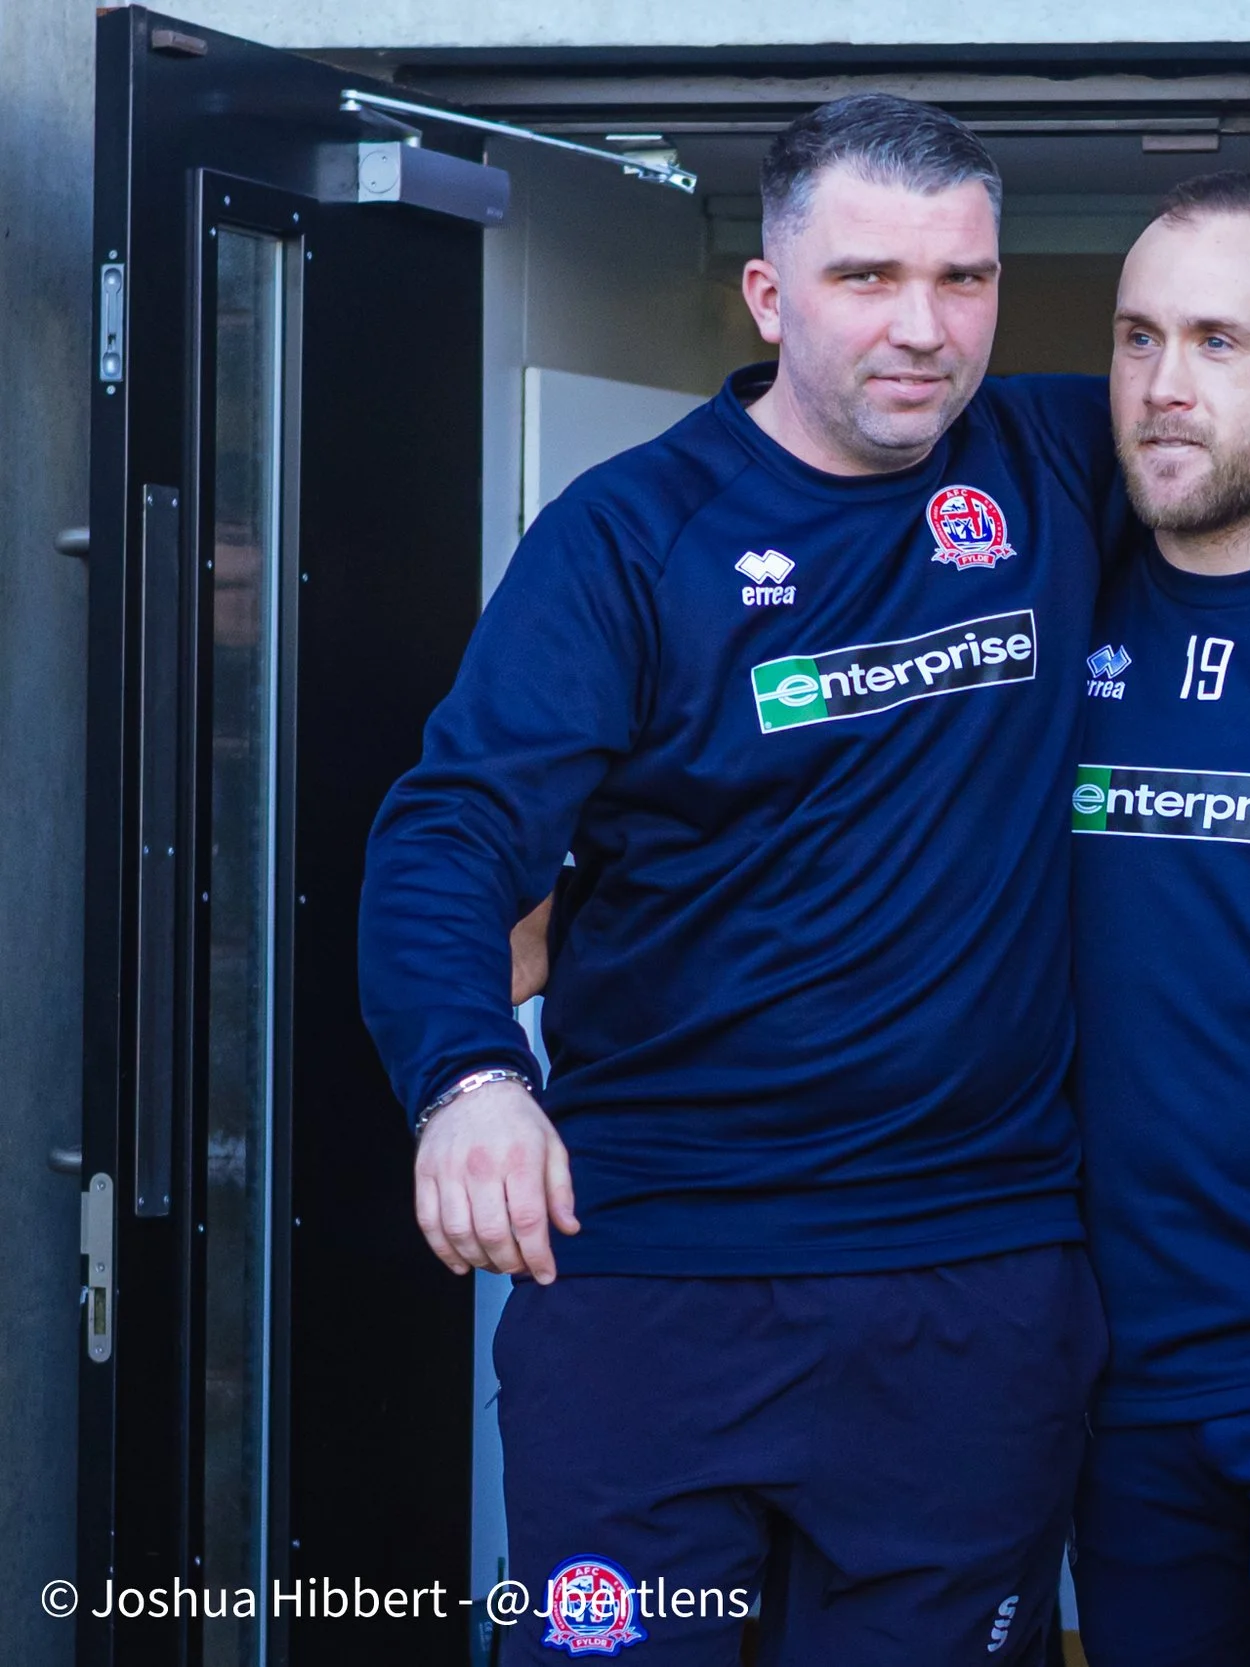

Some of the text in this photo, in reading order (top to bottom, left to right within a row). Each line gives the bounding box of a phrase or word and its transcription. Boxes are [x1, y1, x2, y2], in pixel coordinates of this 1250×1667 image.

[946, 490, 968, 499] AFC
[962, 555, 989, 565] FYLDE
[774, 632, 1032, 707] enterprise
[1180, 635, 1234, 700] 19
[1087, 680, 1126, 700] rrea
[575, 1567, 600, 1577] AFC
